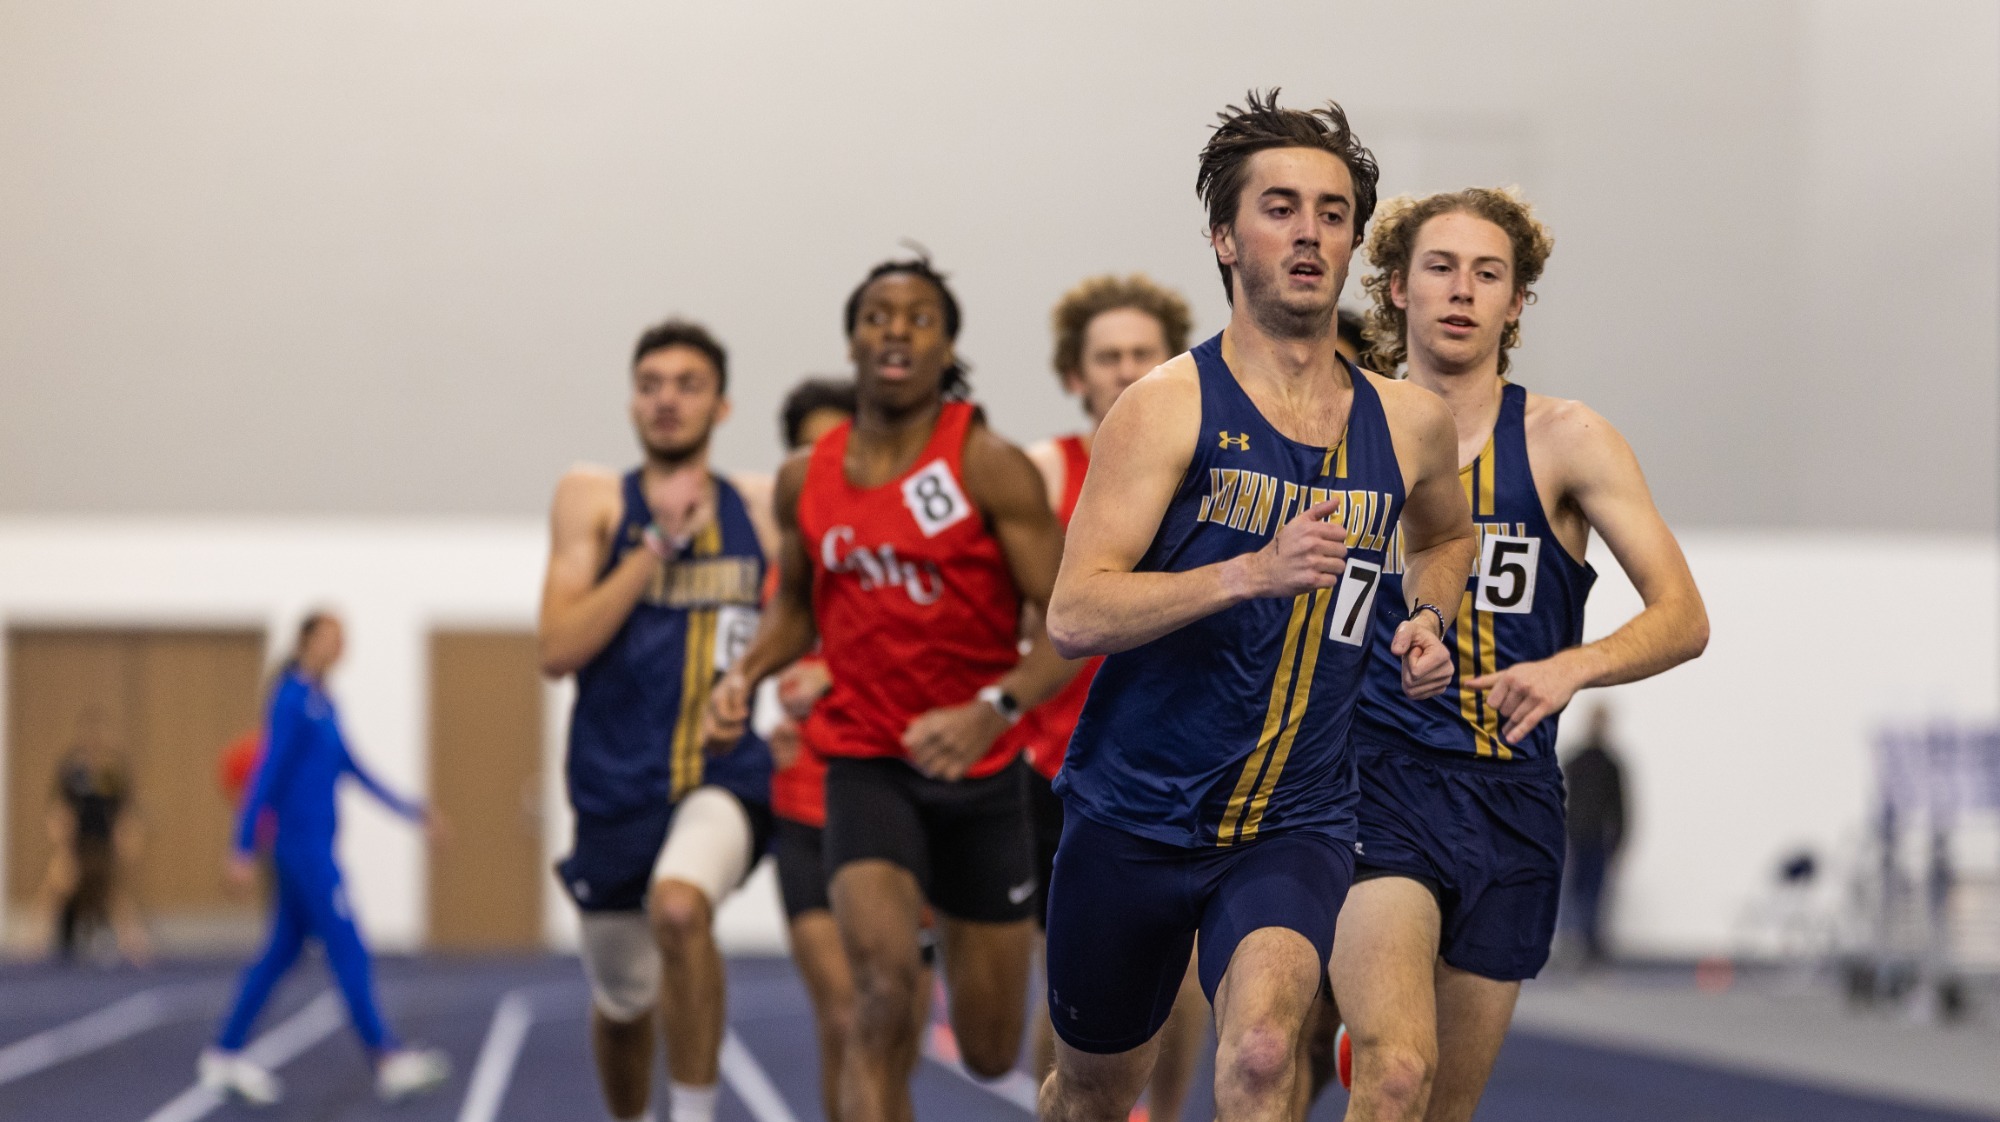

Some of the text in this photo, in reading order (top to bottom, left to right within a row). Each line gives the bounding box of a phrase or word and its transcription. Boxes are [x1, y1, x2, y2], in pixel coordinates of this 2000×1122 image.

[916, 475, 953, 521] 8
[1197, 468, 1278, 536] JOHN
[821, 524, 944, 605] CMU
[1485, 541, 1529, 607] 5
[1341, 566, 1377, 637] 7
